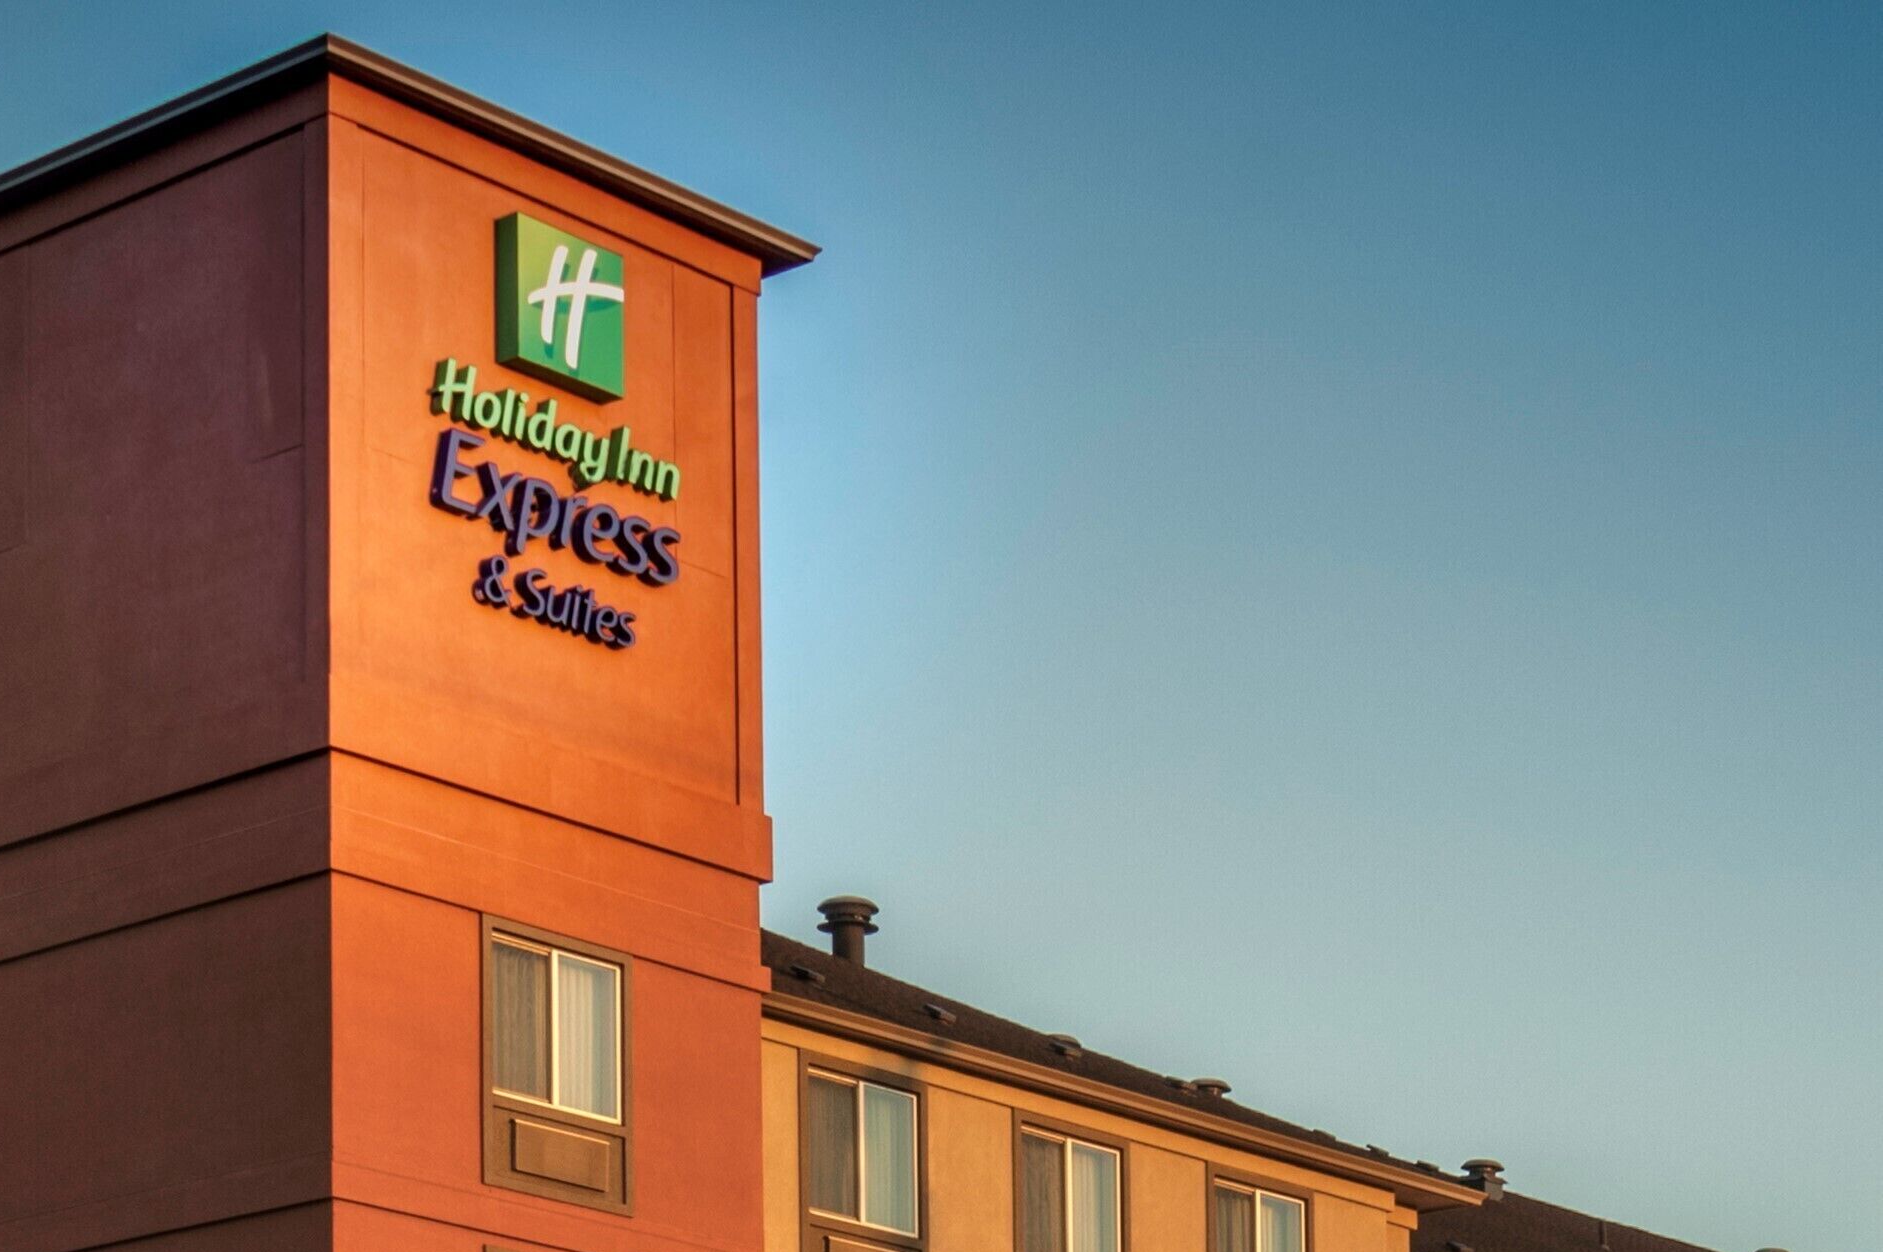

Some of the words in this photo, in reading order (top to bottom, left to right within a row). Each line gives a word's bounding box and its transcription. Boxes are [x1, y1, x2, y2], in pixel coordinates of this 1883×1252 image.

[432, 358, 611, 489] Holiday
[613, 426, 681, 501] Inn
[431, 429, 680, 586] Express
[474, 555, 511, 605] &
[514, 568, 636, 648] Suites
